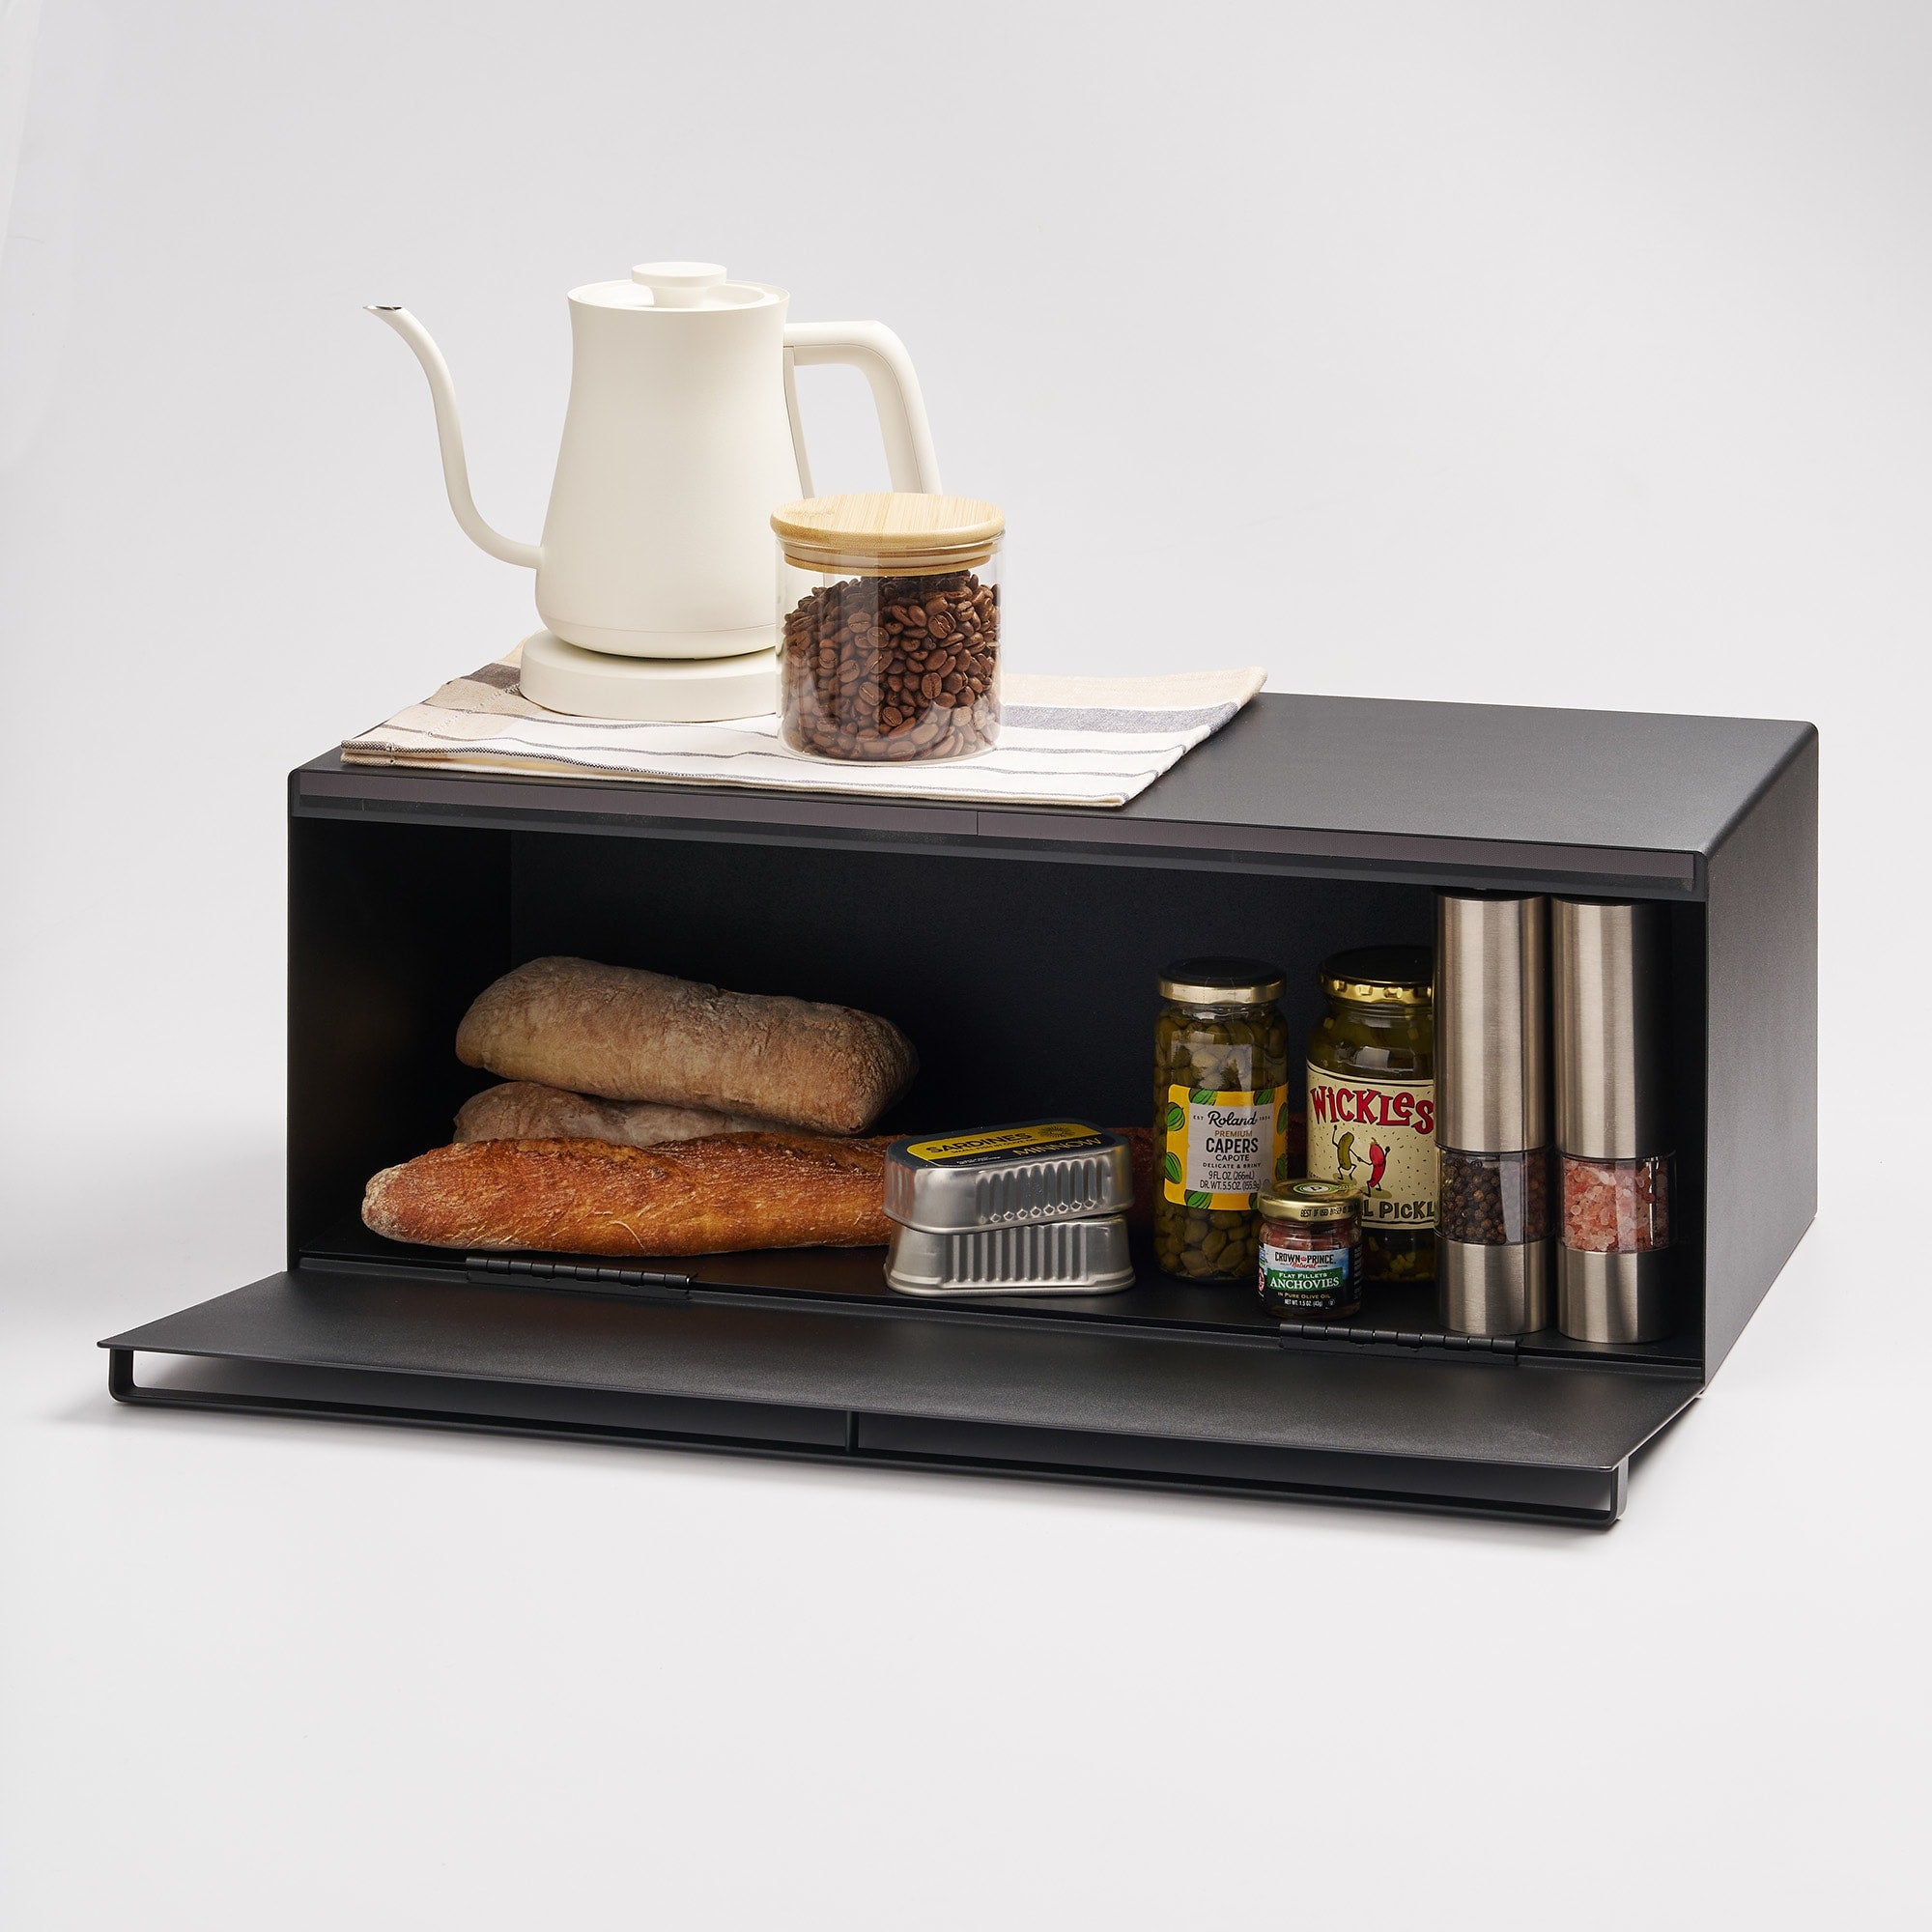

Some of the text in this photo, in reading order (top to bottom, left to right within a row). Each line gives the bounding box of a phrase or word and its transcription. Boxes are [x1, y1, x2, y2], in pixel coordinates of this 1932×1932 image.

[1208, 1110, 1258, 1127] Roland
[925, 1132, 1033, 1153] SARDINES
[1012, 1137, 1102, 1156] MINNOW
[1206, 1137, 1259, 1153] CAPERS
[1208, 1170, 1213, 1179] 9
[1378, 1201, 1435, 1219] PICKL
[1275, 1251, 1301, 1263] CROWN
[1307, 1254, 1335, 1264] PRINCE
[1290, 1261, 1317, 1269] Natural
[1270, 1277, 1339, 1290] ANCHOVIES
